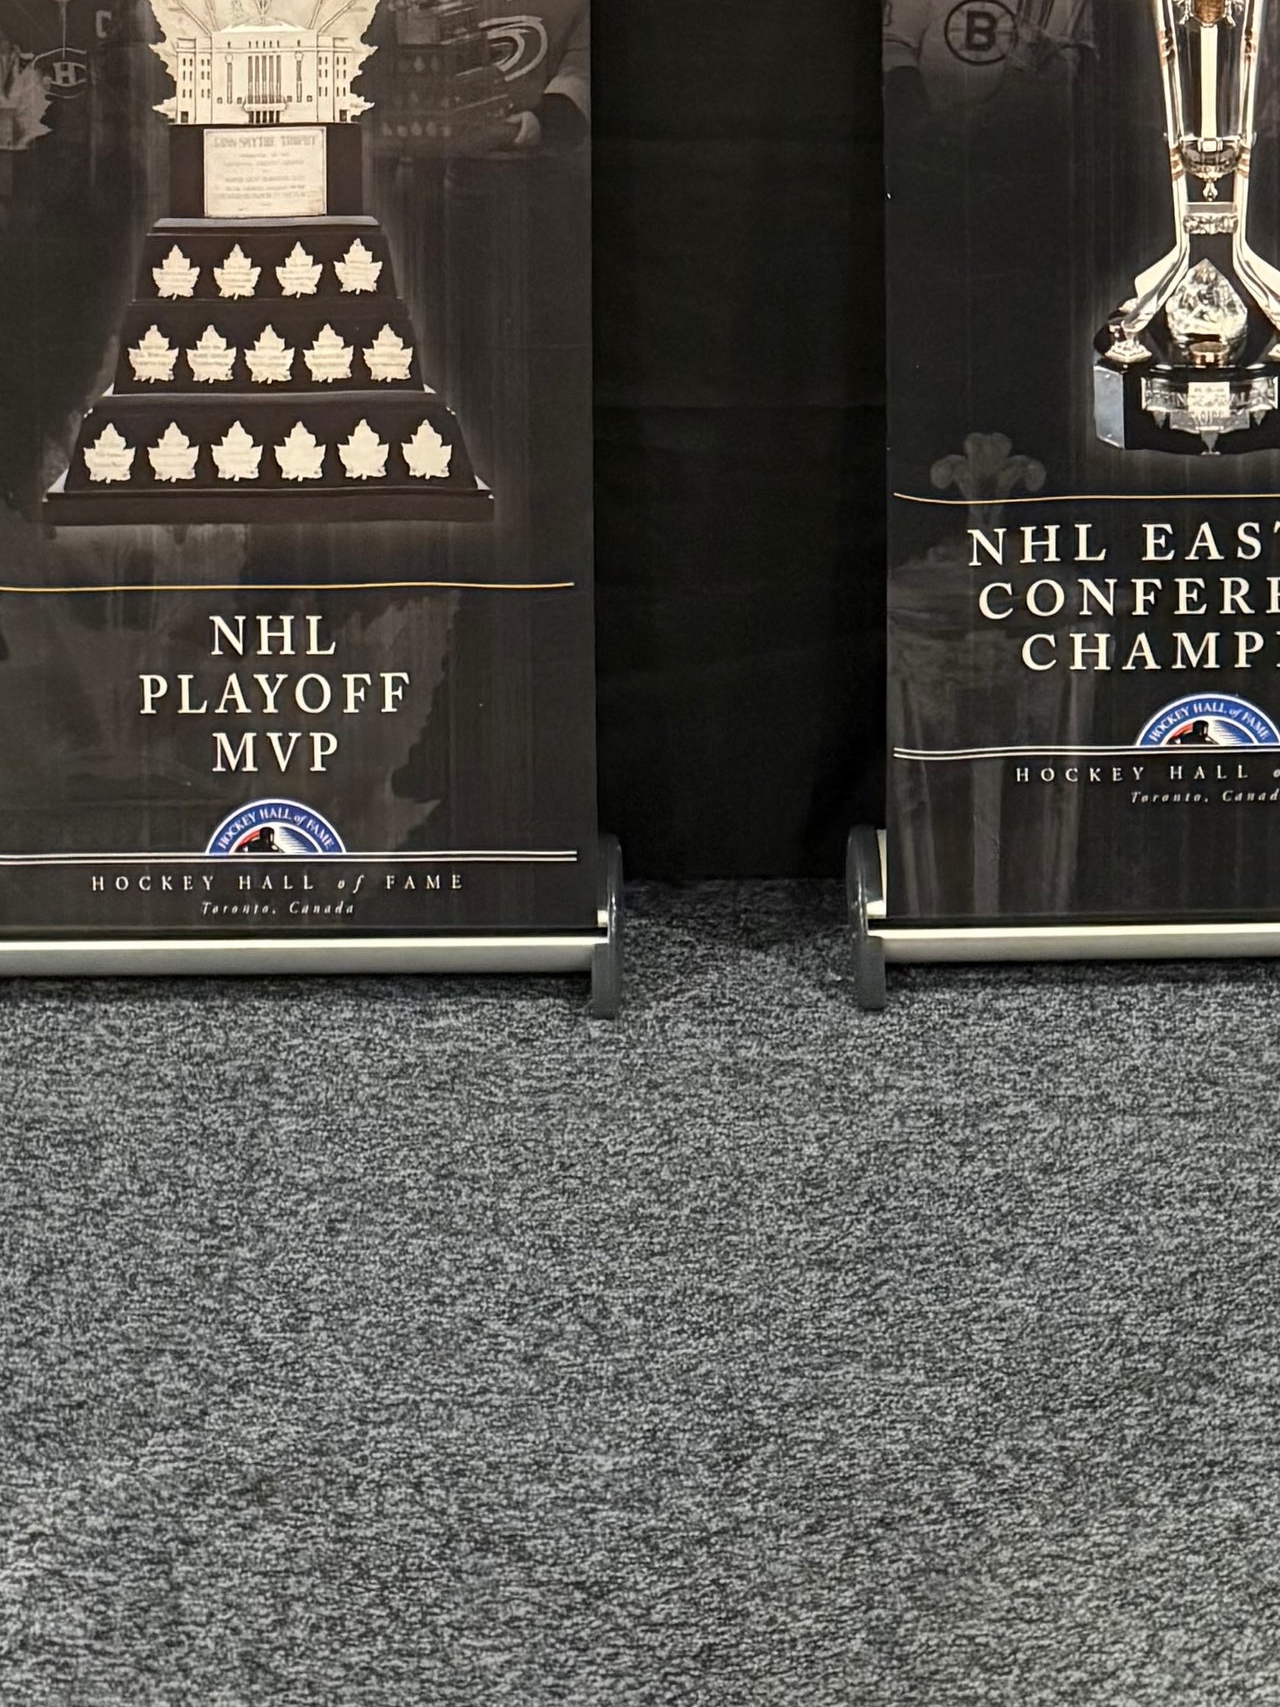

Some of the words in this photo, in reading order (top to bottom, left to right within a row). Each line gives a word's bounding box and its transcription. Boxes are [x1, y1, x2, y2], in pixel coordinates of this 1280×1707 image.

[967, 523, 1107, 567] NHL
[209, 614, 336, 656] NHL
[138, 672, 410, 714] PLAYOFF
[211, 732, 338, 772] MVP
[1016, 766, 1144, 783] HOCKEY
[91, 875, 213, 892] HOCKEY
[239, 874, 314, 890] HALL
[337, 874, 365, 894] of
[386, 874, 462, 890] FAME
